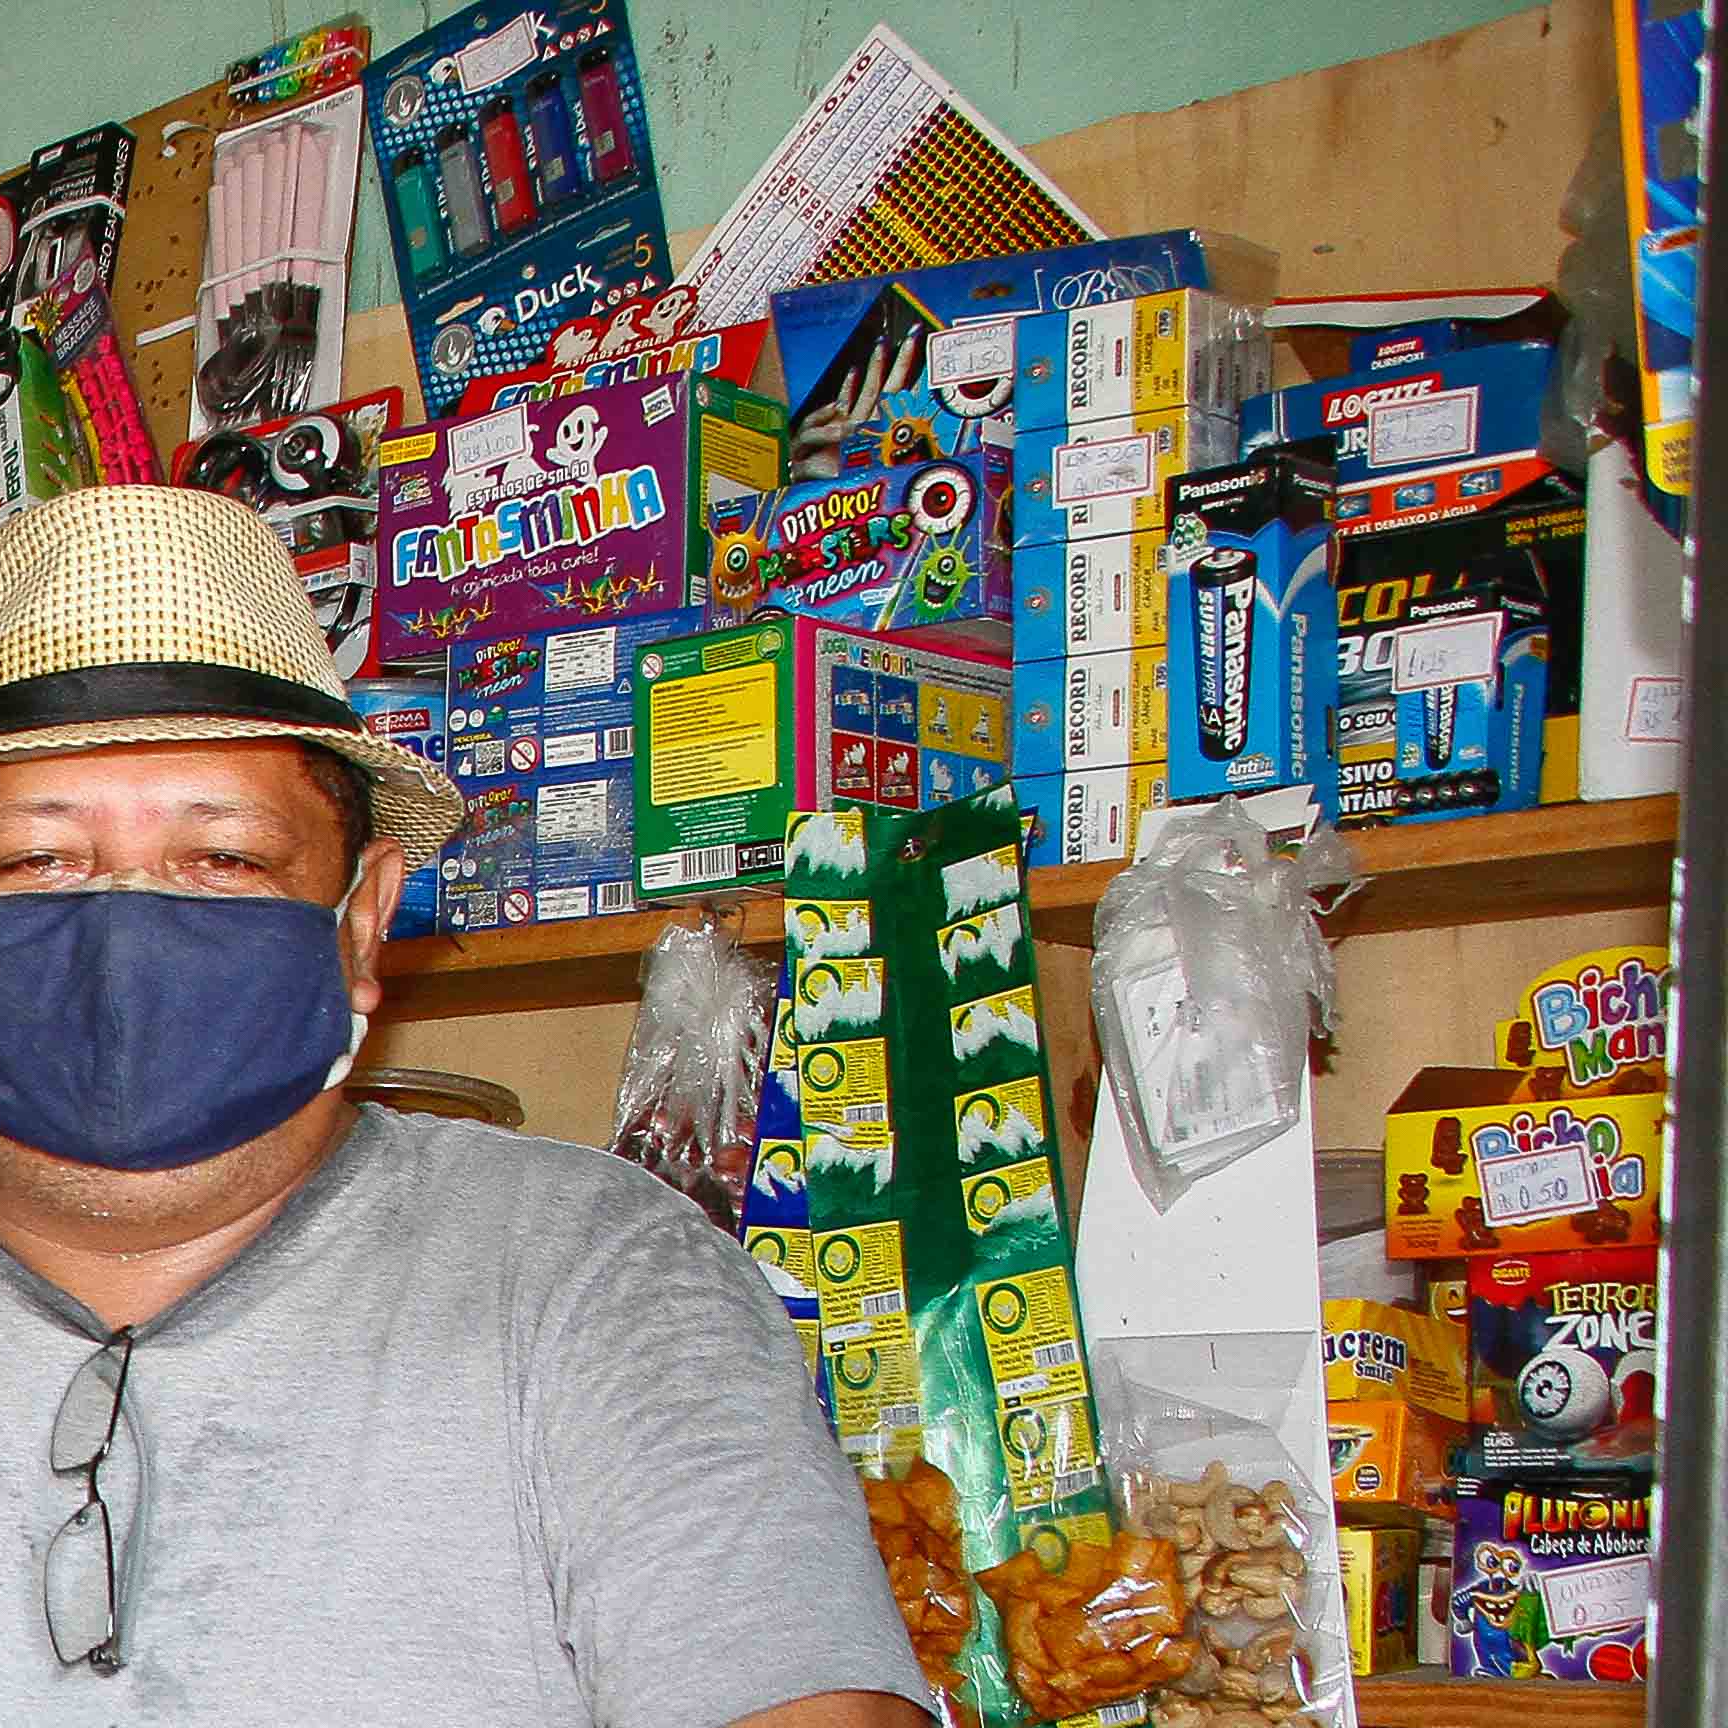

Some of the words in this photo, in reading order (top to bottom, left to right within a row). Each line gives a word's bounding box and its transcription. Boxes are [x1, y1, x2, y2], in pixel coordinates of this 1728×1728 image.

[1072, 319, 1089, 410] RECORD
[1327, 379, 1433, 423] LOCTITE
[467, 484, 521, 506] ESTALOS
[523, 478, 542, 494] DE
[545, 461, 588, 486] SALÃO
[1179, 468, 1266, 500] Panasonic
[393, 465, 665, 586] FANTASMINHA
[1375, 513, 1427, 532] DEBAIXO
[1072, 553, 1089, 644] RECORD
[1411, 596, 1478, 619] Panasonic
[1199, 590, 1215, 657] SUPER
[1200, 658, 1216, 707] HYPER
[1224, 576, 1253, 751] Panasonic
[375, 711, 424, 723] GOMA
[1070, 668, 1088, 757] RECORD
[1291, 613, 1307, 777] Panasonic
[1569, 1024, 1666, 1086] Man
[1471, 1108, 1621, 1158] Bicho
[1492, 1268, 1531, 1280] GIGANTE
[1543, 1311, 1656, 1352] ZONE
[1354, 1361, 1394, 1384] Smile
[1531, 1533, 1574, 1558] Cabeça
[1577, 1534, 1591, 1554] de
